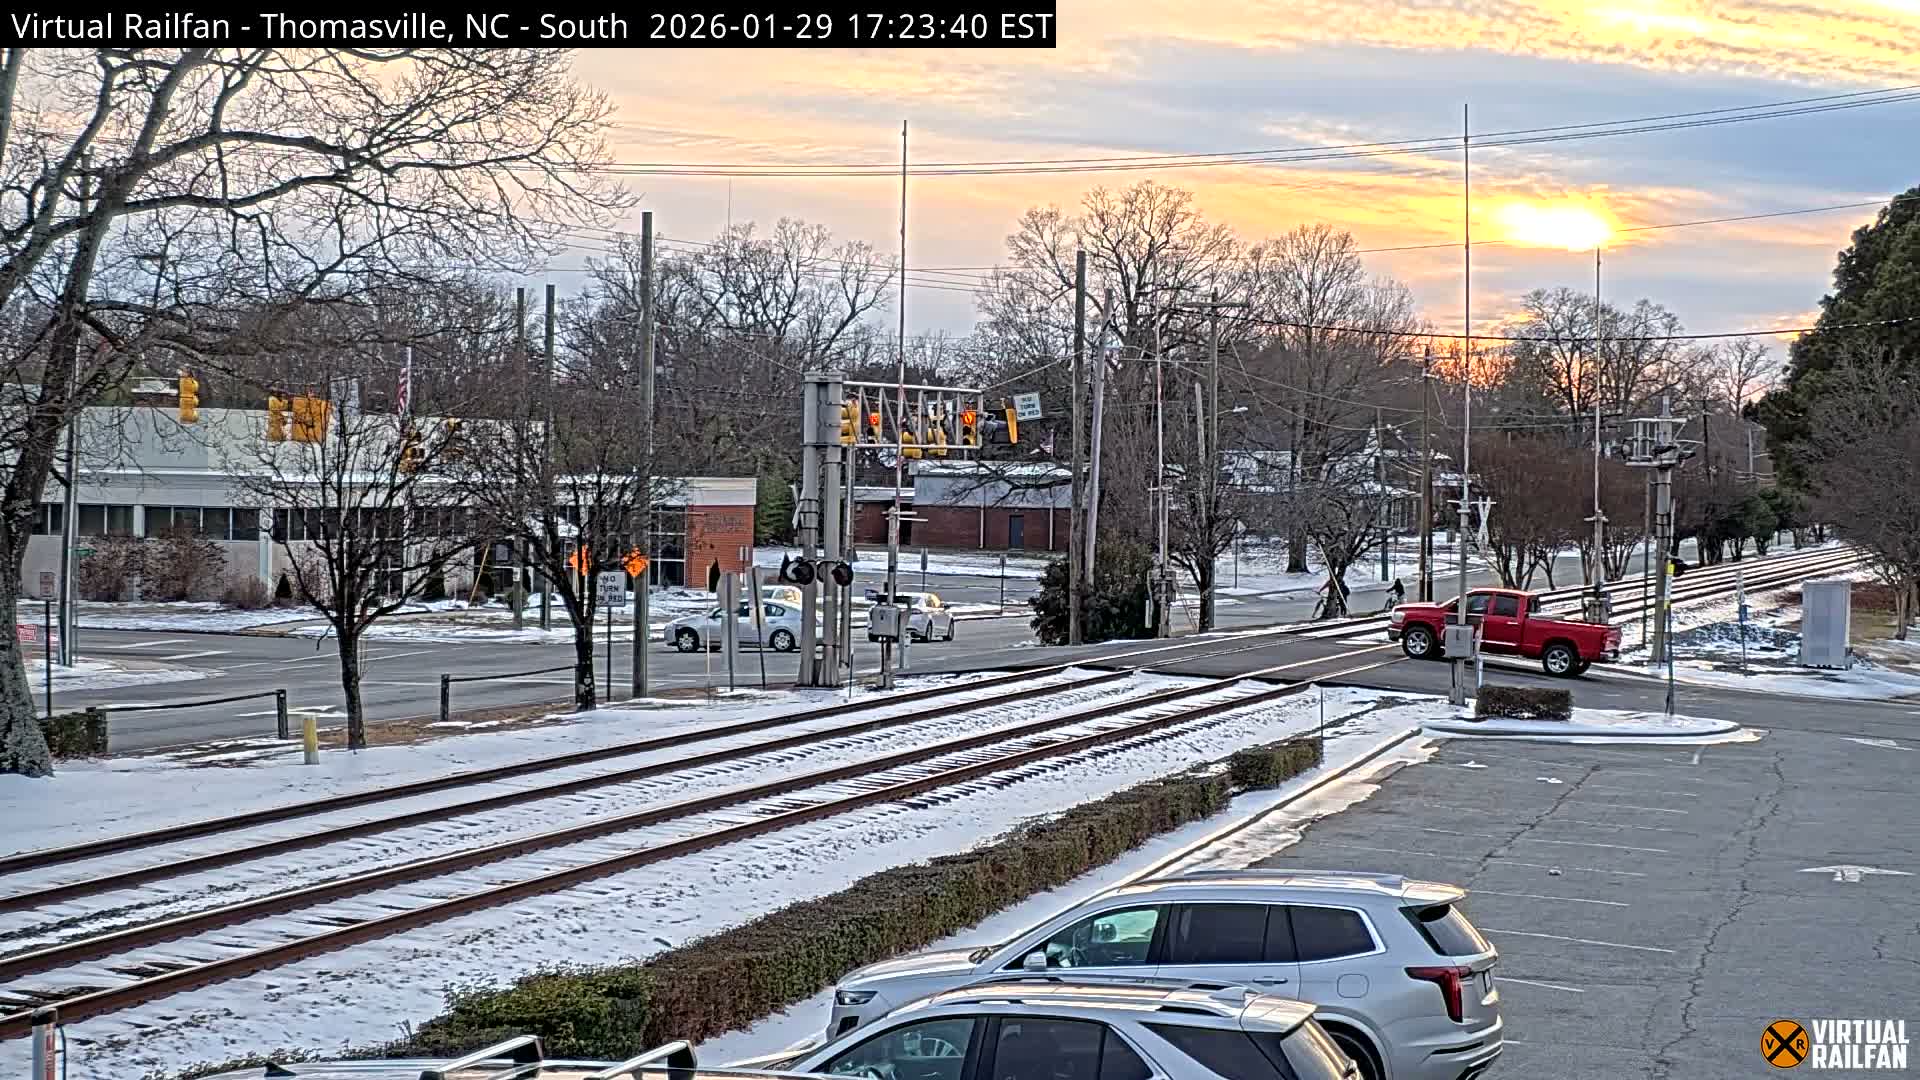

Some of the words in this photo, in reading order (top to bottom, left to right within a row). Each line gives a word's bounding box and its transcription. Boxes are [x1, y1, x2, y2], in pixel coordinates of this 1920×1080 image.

[600, 575, 616, 583] NO
[600, 584, 619, 592] TURN
[608, 594, 623, 602] RED
